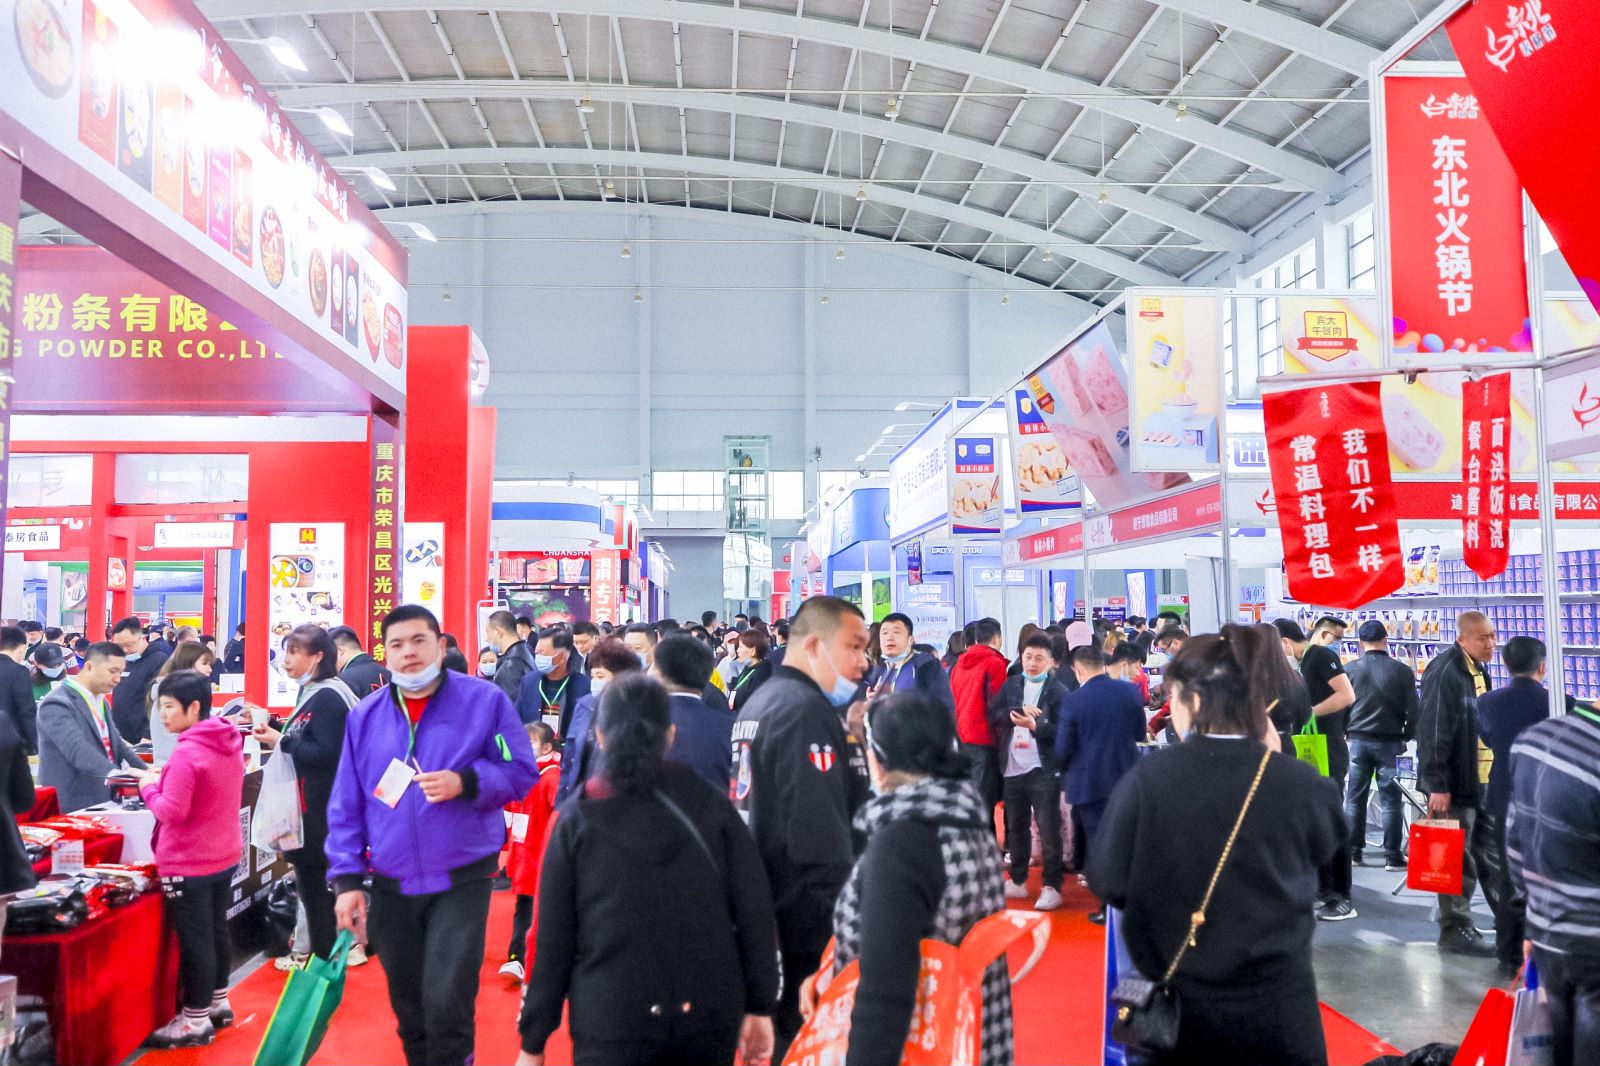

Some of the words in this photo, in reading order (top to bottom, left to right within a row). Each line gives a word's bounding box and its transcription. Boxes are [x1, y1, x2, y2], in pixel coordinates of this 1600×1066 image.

[1432, 135, 1473, 316] 东北火锅节
[23, 293, 238, 333] 粉条有限
[38, 339, 163, 359] POWDER
[177, 339, 284, 361] CO.,LT
[1311, 326, 1342, 336] 午餐肉
[1290, 434, 1335, 579] 常温料理包
[1342, 428, 1384, 573] 我们不一样
[1466, 421, 1481, 549] 餐台酱料
